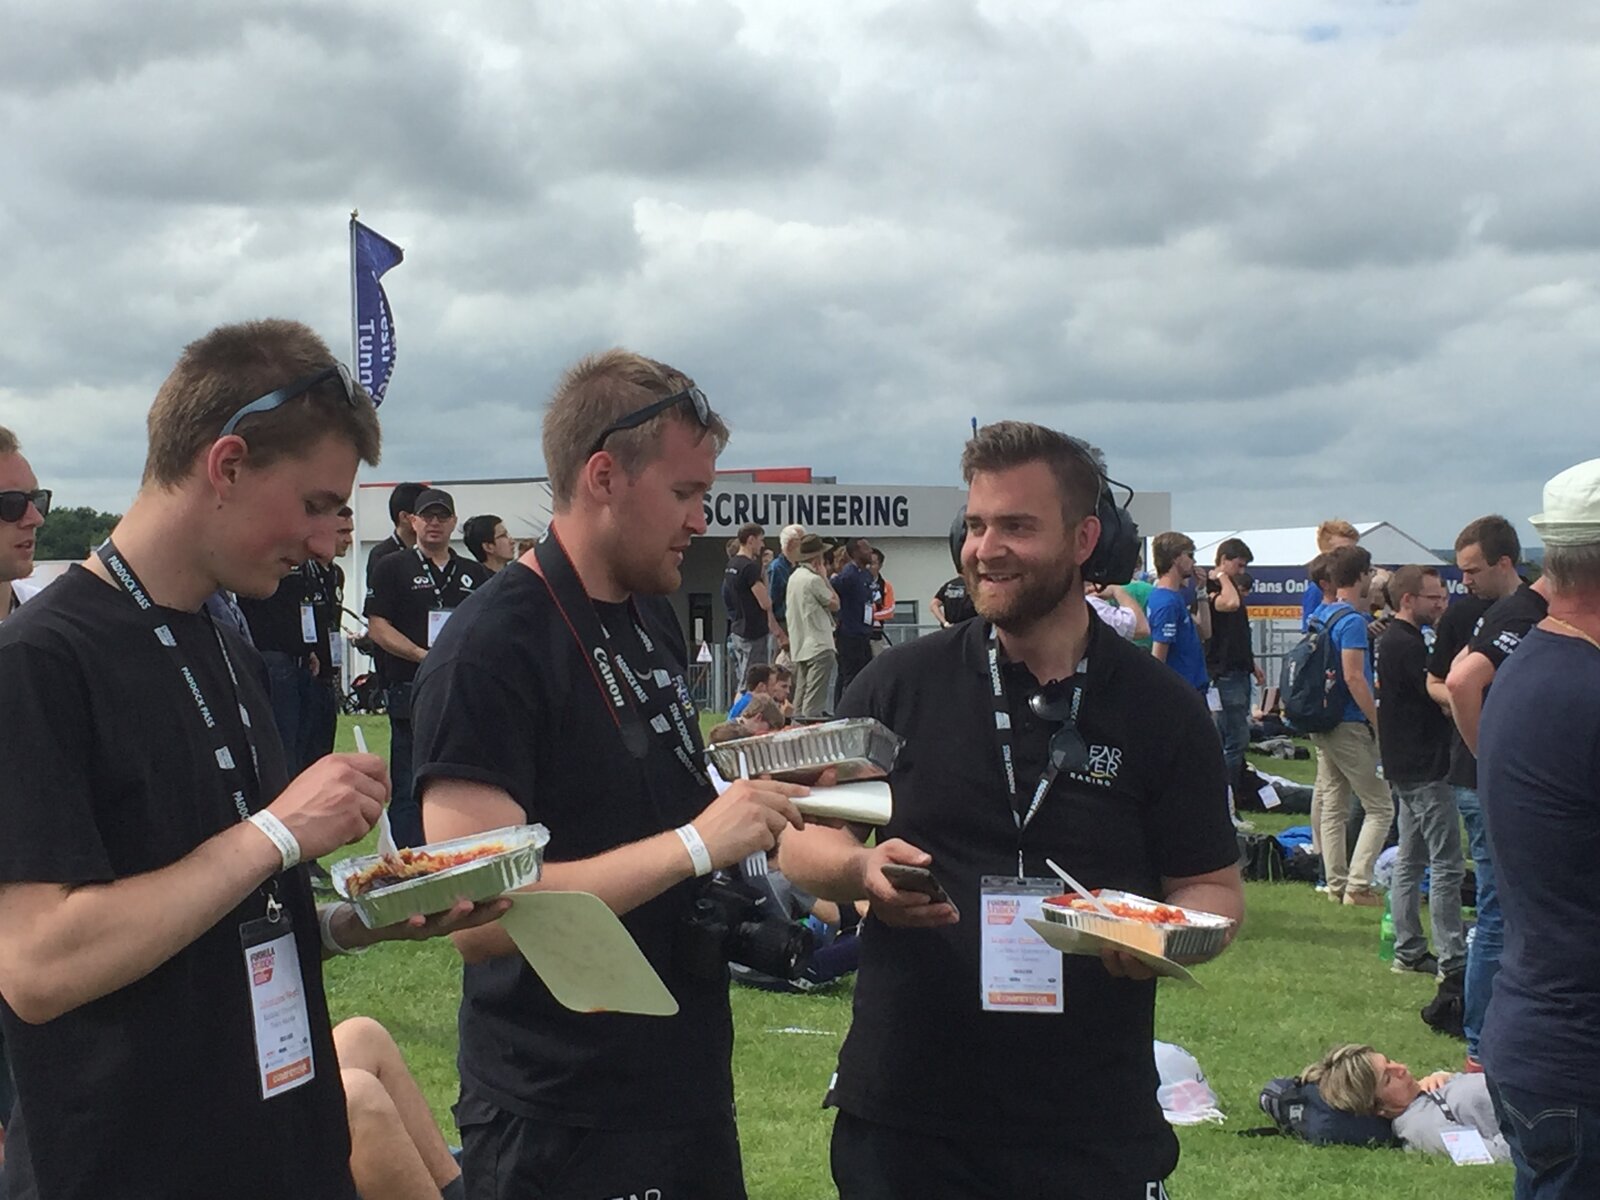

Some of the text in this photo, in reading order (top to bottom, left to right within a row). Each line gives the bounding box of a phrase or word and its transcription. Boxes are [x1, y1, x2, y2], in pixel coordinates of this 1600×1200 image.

[703, 492, 909, 527] SCRUTINEERING
[108, 555, 151, 610] PADDOCK PASS
[1285, 579, 1309, 593] Onl
[593, 647, 625, 706] Canon
[614, 654, 650, 704] PADDOCK PASS
[988, 648, 1002, 696] PADDOCK PASS
[181, 666, 215, 728] PADDOCK PASS
[669, 702, 683, 721] PASS
[676, 720, 697, 755] PADDOCK
[1089, 745, 1123, 765] EAR
[1005, 762, 1017, 794] PADDOCK
[1070, 771, 1111, 787] RACING
[232, 790, 250, 820] PADDO
